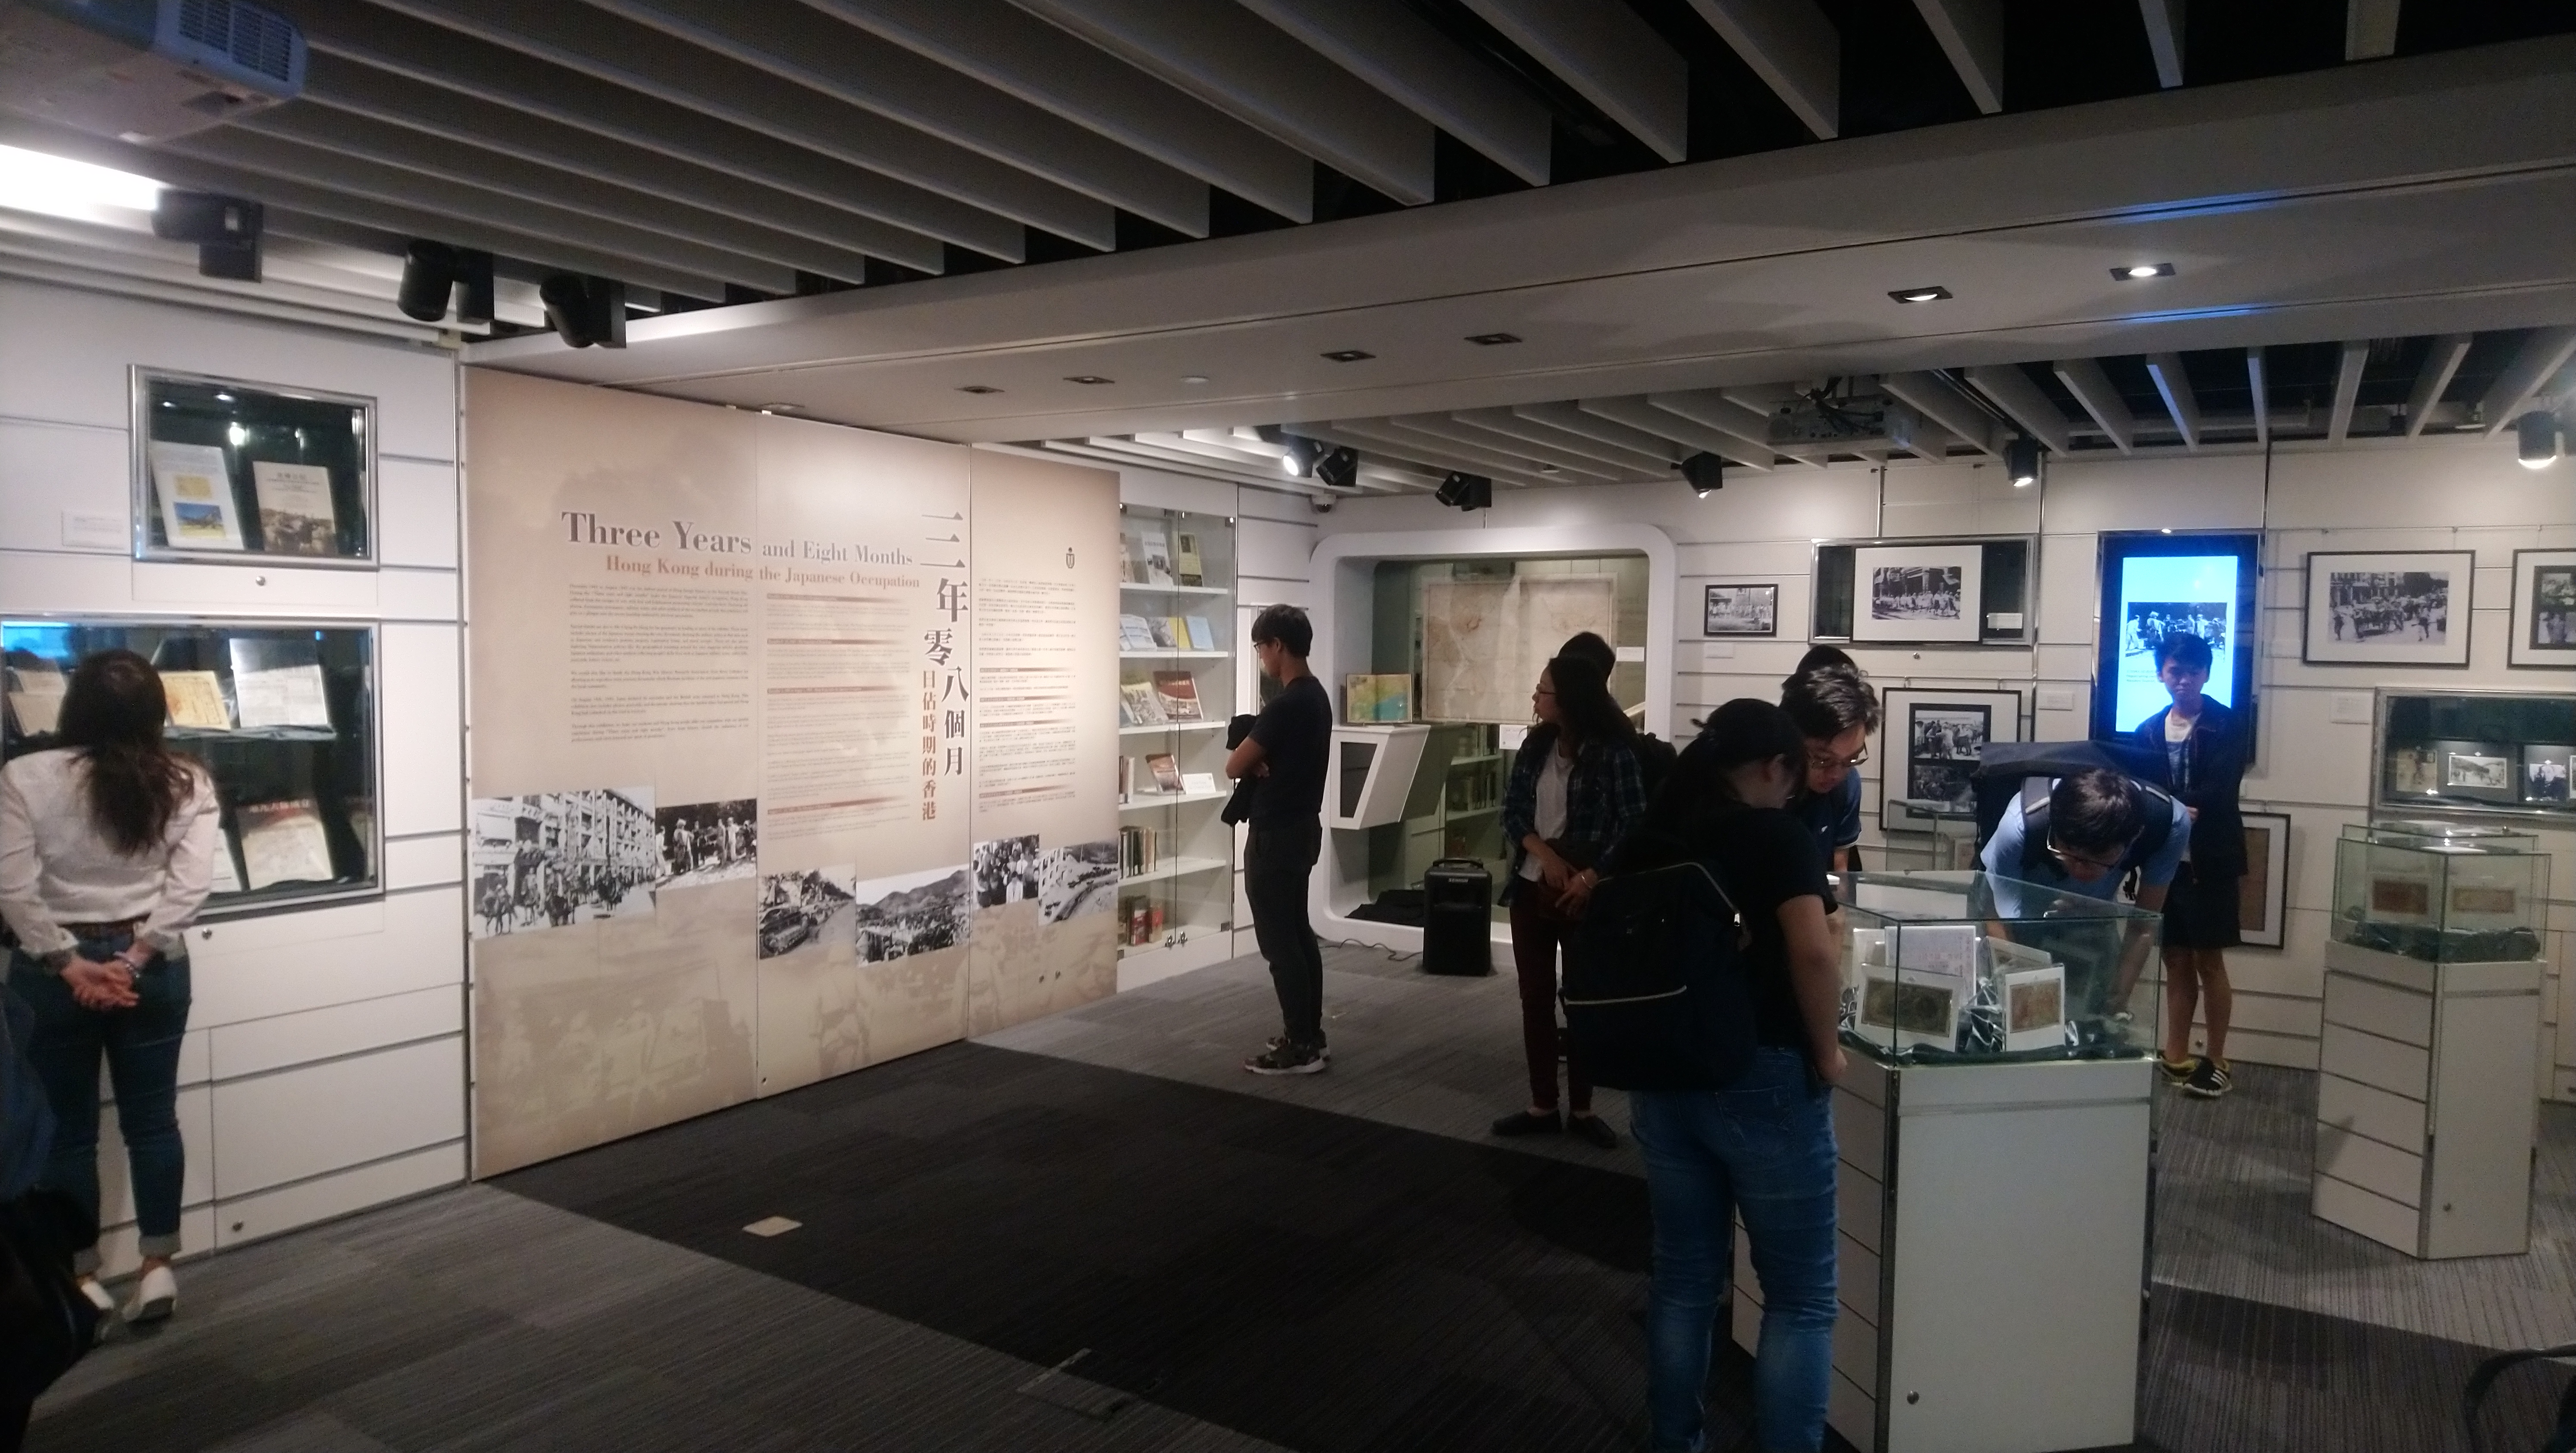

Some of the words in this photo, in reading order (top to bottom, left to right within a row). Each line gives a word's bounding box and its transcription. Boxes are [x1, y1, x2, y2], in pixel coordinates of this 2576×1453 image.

[561, 511, 660, 548] Three
[673, 520, 752, 554] Years
[763, 539, 795, 558] and
[804, 541, 847, 564] Eight
[855, 544, 913, 565] Months
[607, 555, 651, 575] Hong
[658, 558, 699, 577] Kong
[705, 561, 753, 581] during
[760, 566, 780, 581] the
[785, 567, 845, 586] Japanese
[850, 571, 920, 590] Occupation
[920, 512, 969, 776] 三年零八個月
[923, 670, 936, 821] 日佔時期的香港
